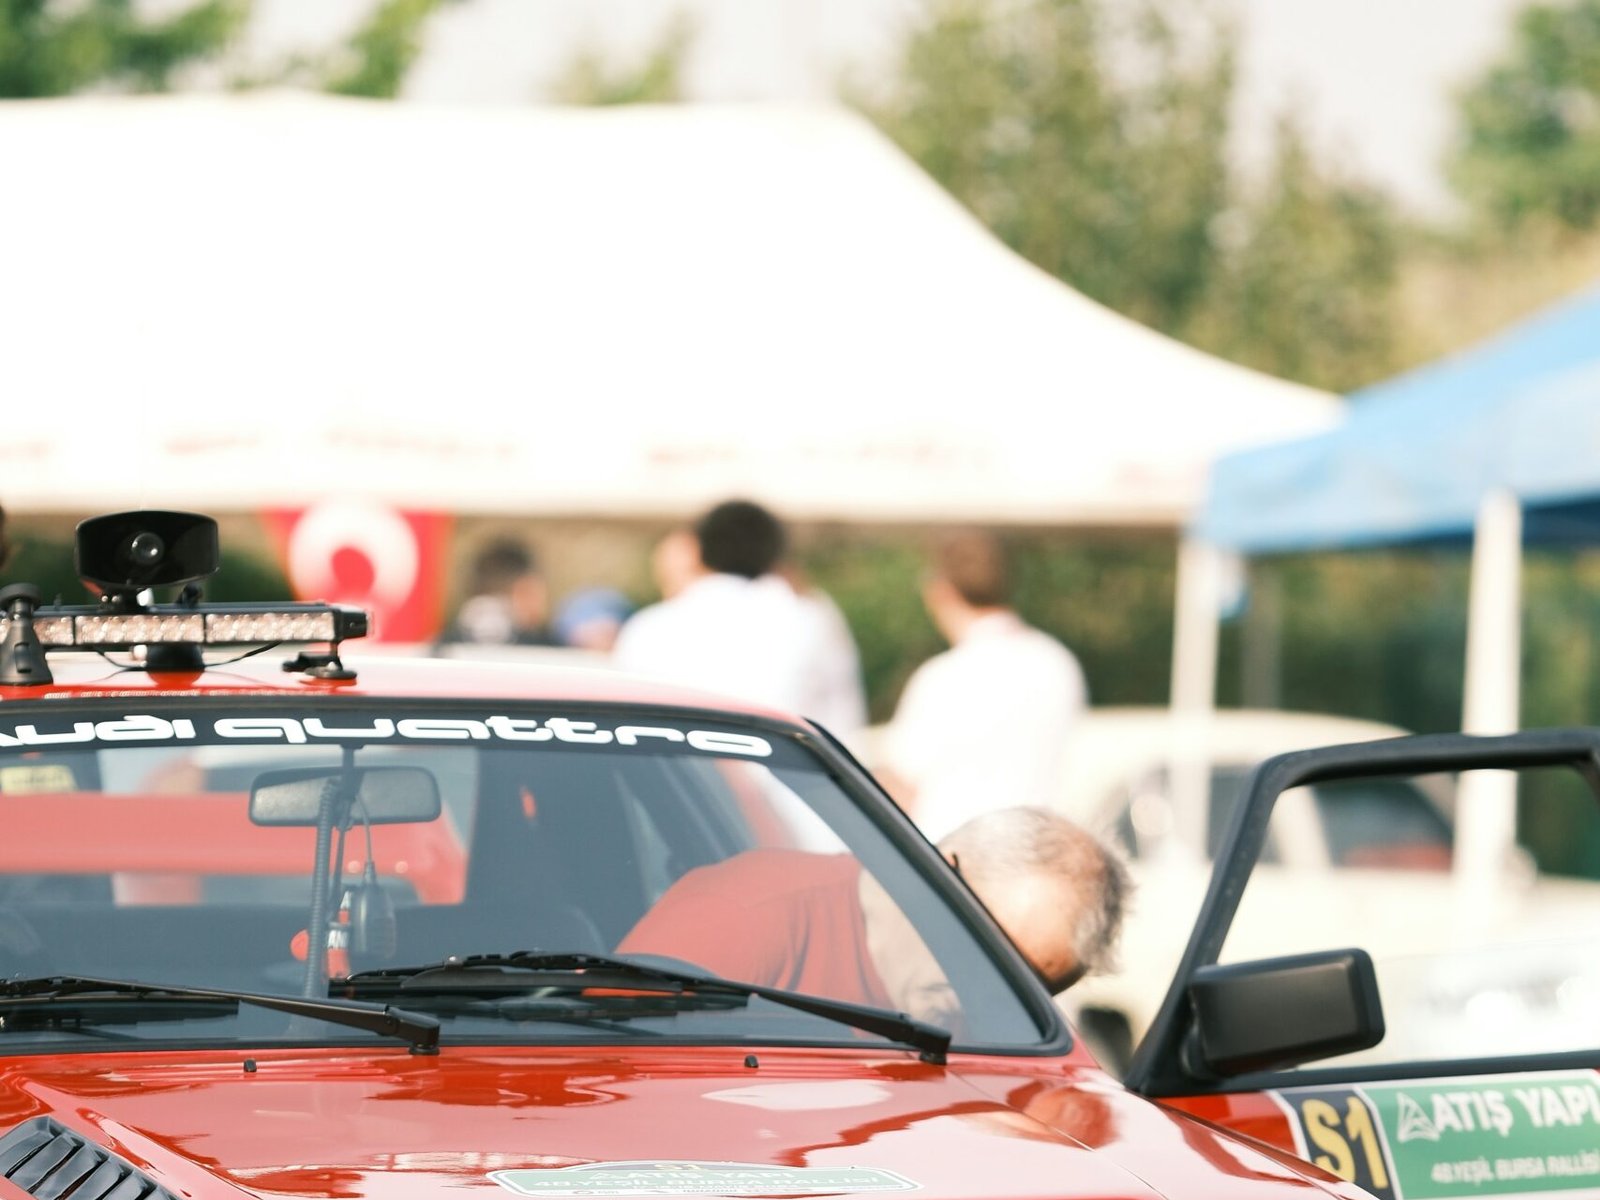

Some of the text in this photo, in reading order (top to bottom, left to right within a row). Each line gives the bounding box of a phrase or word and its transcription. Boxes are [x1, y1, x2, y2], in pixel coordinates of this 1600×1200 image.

[214, 715, 773, 757] quattro
[1431, 1087, 1600, 1136] ATIŞ YAPI
[1301, 1096, 1389, 1188] S1
